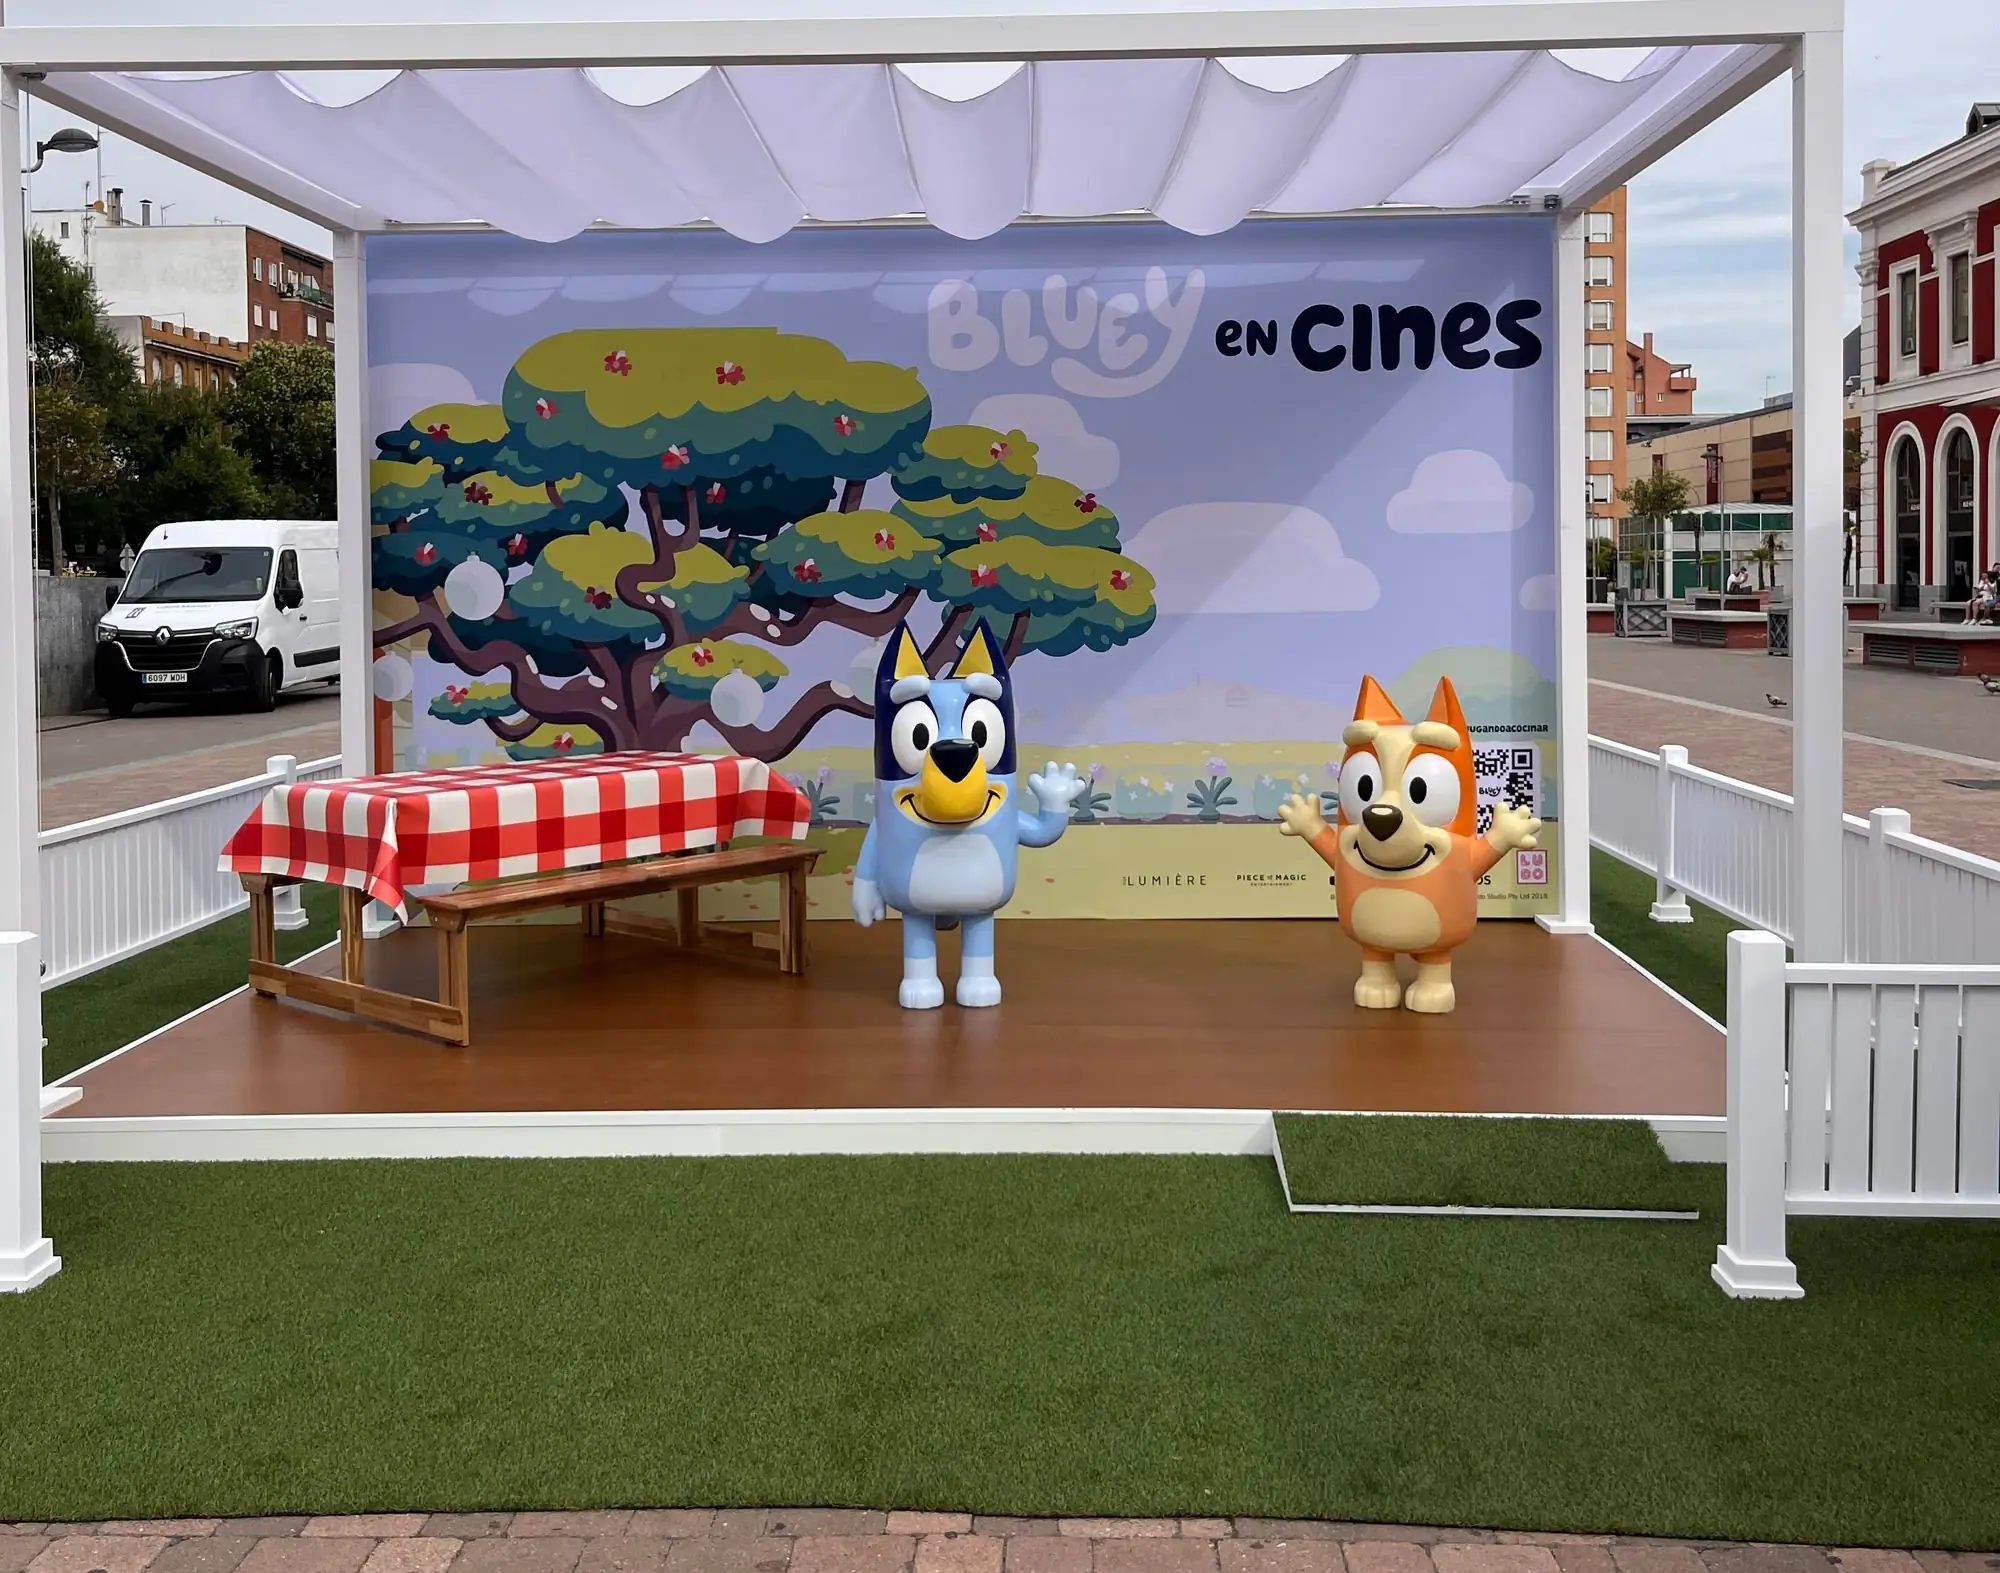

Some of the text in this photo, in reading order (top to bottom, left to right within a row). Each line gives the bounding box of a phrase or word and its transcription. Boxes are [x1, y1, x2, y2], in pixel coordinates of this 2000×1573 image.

[927, 265, 1205, 398] BLUEY
[148, 674, 168, 682] 6097
[1127, 873, 1207, 887] LUMIÈRE
